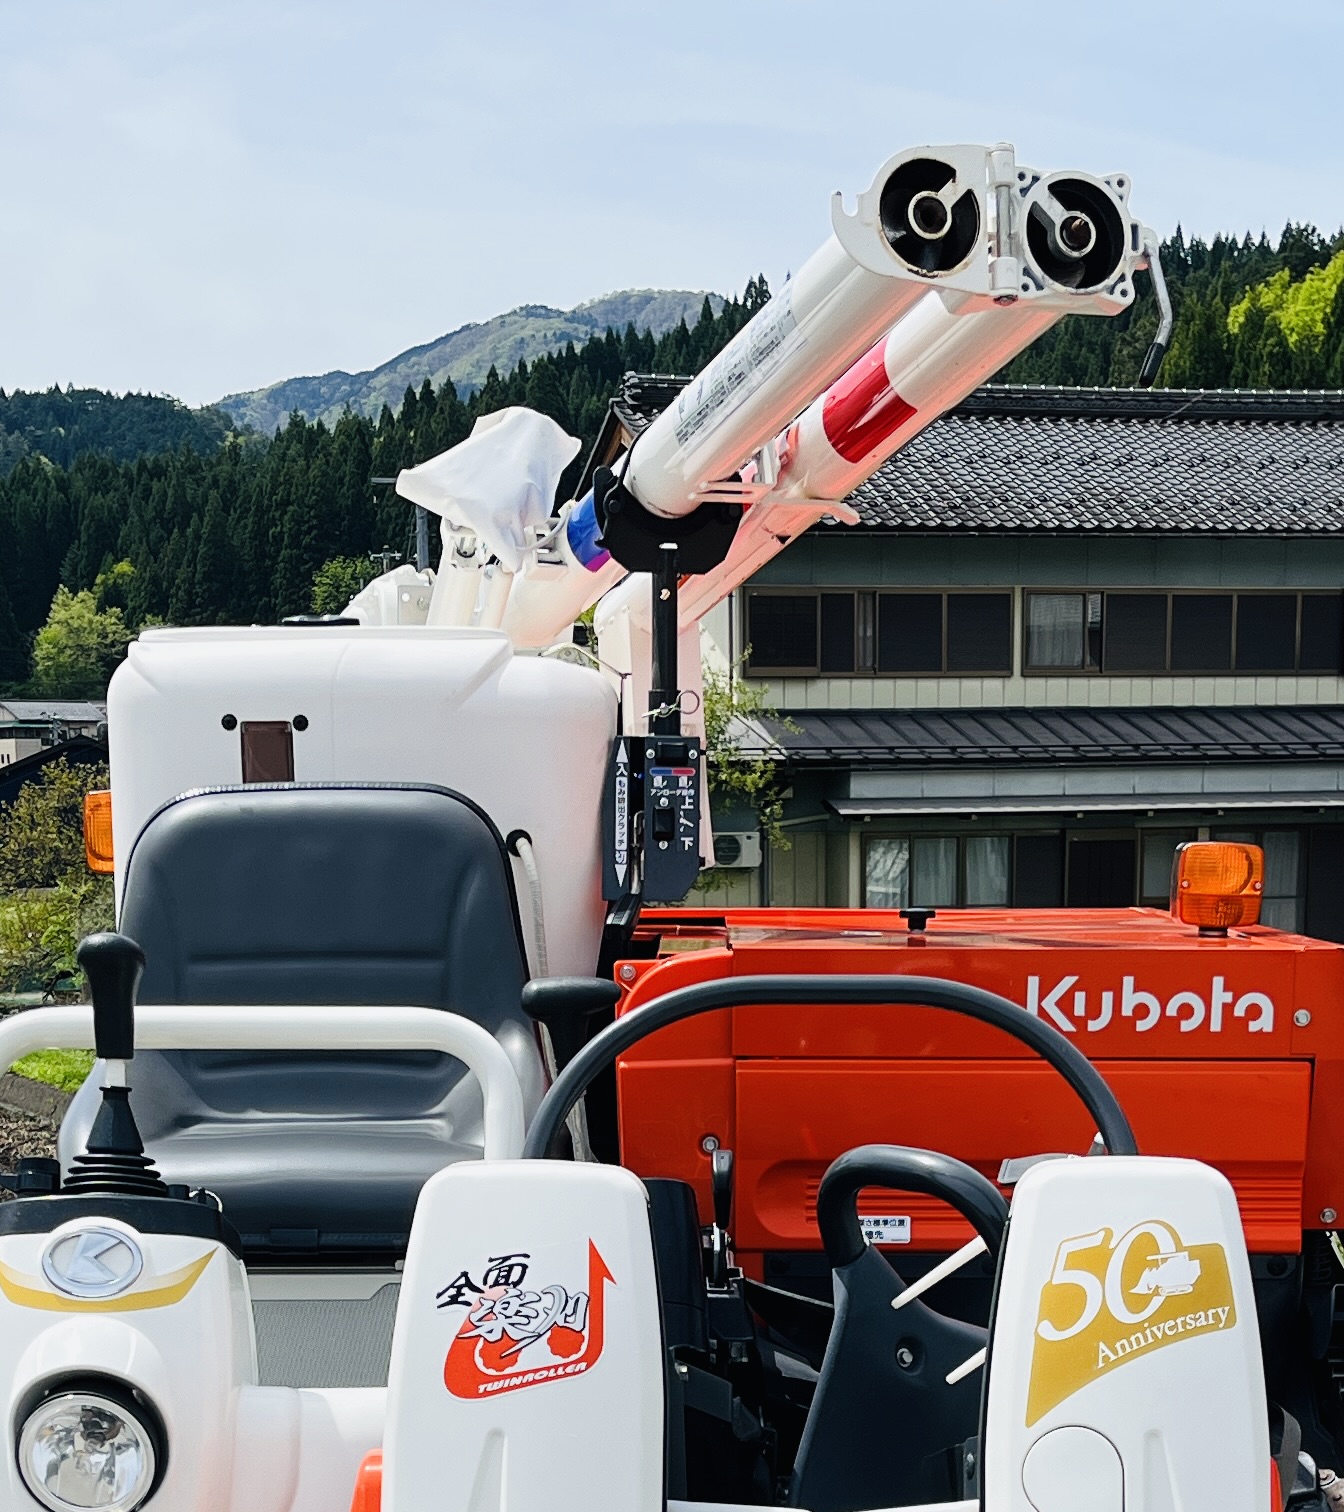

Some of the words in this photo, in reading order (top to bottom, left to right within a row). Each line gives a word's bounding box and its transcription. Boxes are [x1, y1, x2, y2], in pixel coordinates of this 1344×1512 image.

[680, 795, 694, 810] 上
[680, 836, 694, 851] 下
[1026, 975, 1274, 1033] Kubota
[435, 1253, 531, 1309] 全面
[1036, 1222, 1179, 1342] 50
[1096, 1305, 1231, 1370] Anniversary
[477, 1361, 588, 1394] TWINROLLER
